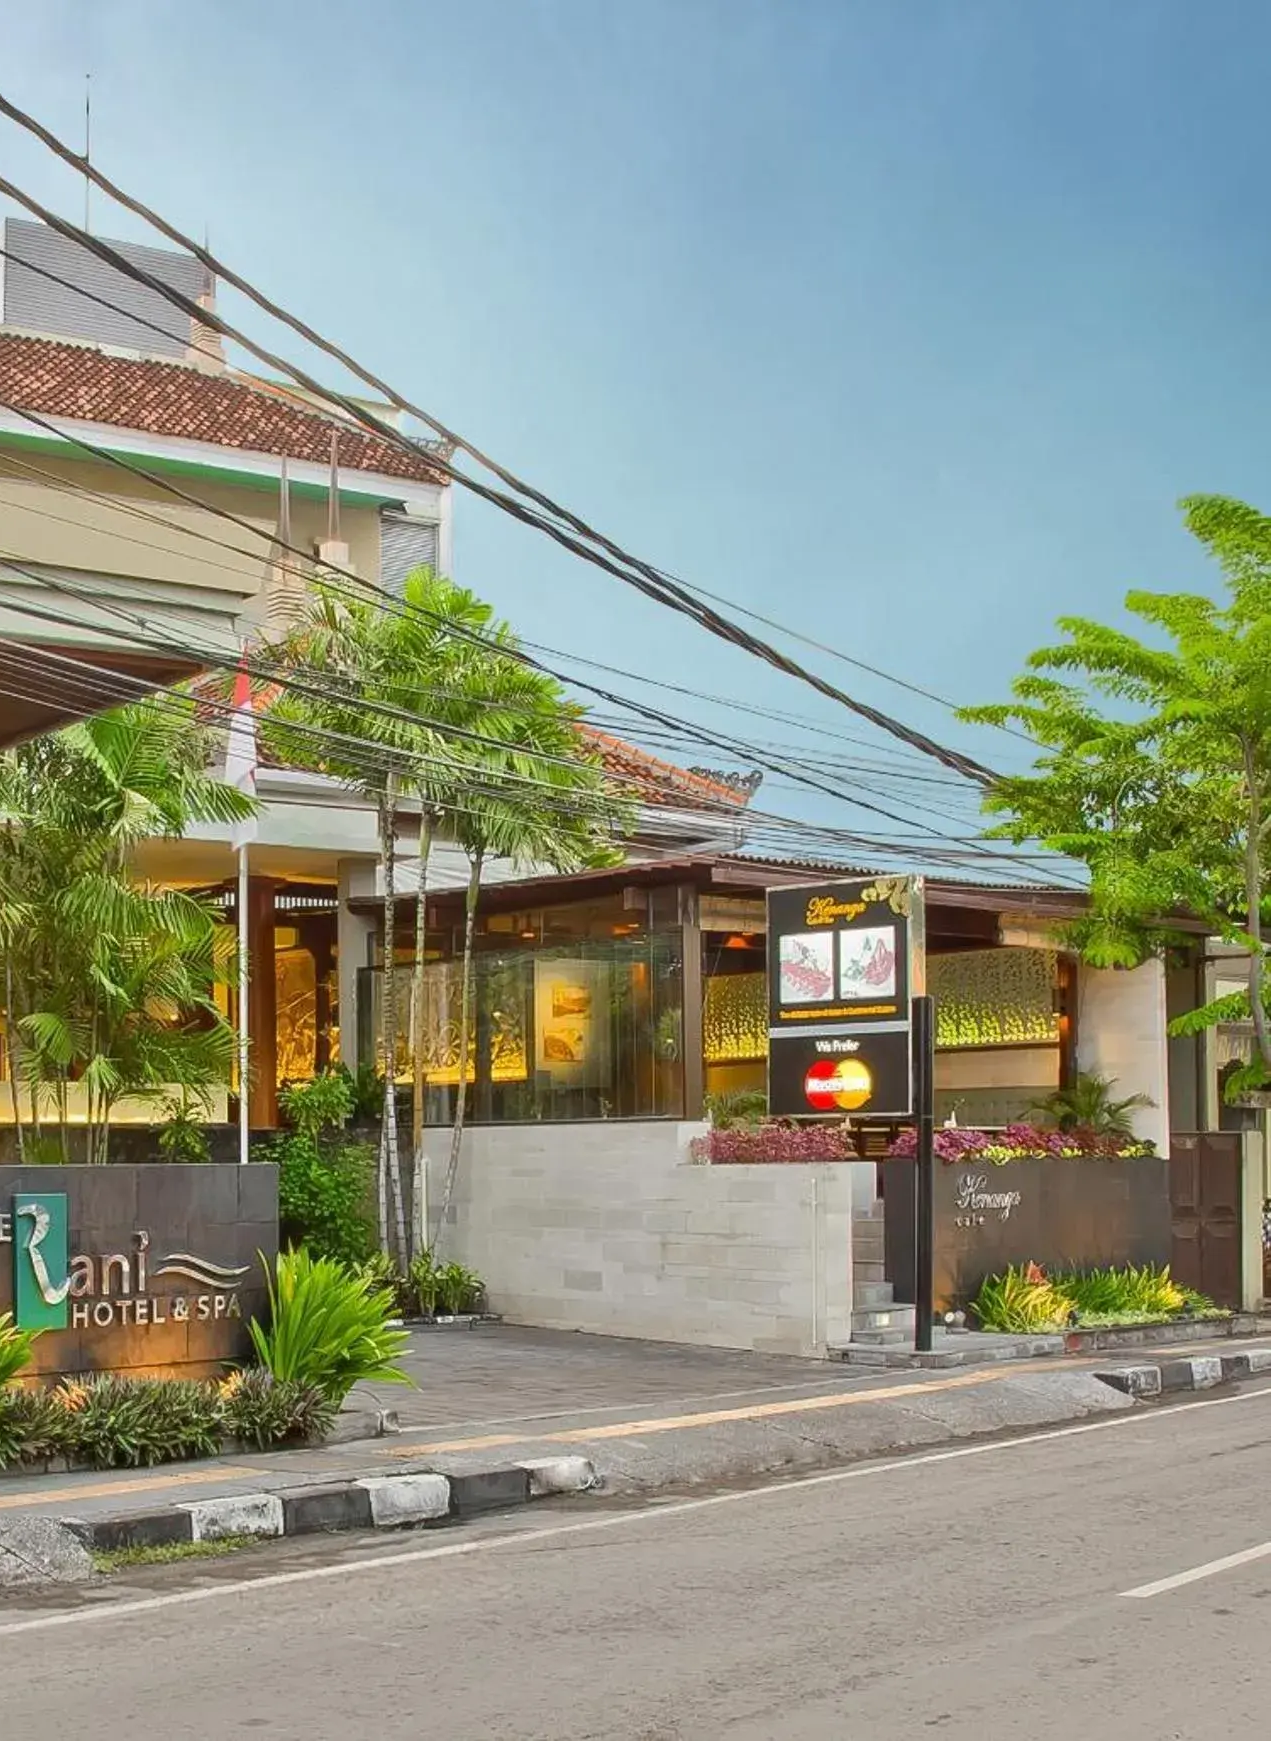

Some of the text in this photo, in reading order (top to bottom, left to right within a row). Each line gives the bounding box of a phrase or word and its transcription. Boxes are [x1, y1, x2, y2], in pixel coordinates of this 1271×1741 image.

[17, 1203, 149, 1304] Rani
[72, 1293, 242, 1329] HOTEL & SPA
